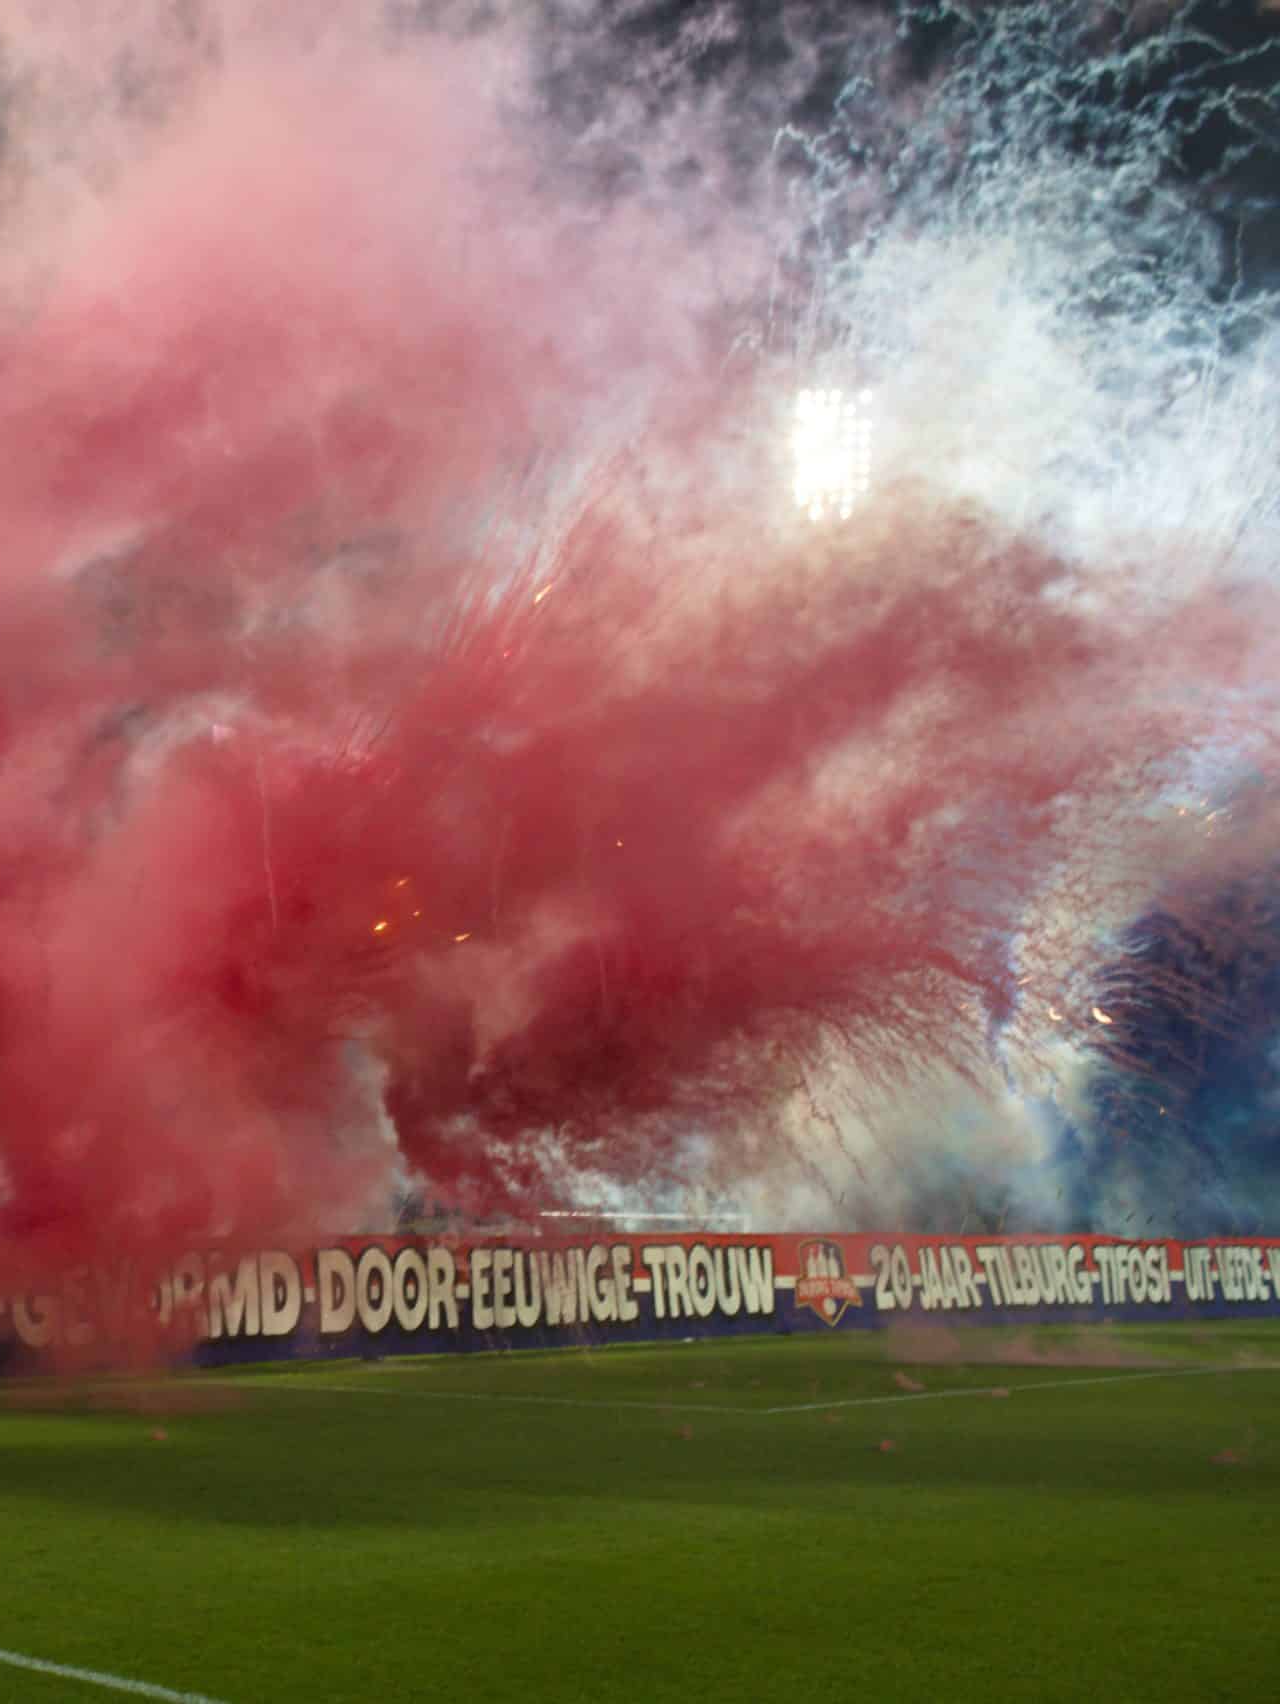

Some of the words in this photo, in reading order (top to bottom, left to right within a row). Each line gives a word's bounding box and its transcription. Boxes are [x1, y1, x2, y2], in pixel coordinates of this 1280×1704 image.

[318, 1247, 459, 1335] DOOR
[470, 1244, 638, 1330] EEUWIGE
[643, 1244, 776, 1318] TROUW
[871, 1244, 913, 1311] 20
[919, 1245, 984, 1310] JAAR
[978, 1243, 1094, 1307] TILBURG
[1094, 1243, 1172, 1305] TIFOSI
[1183, 1246, 1215, 1302] UIT
